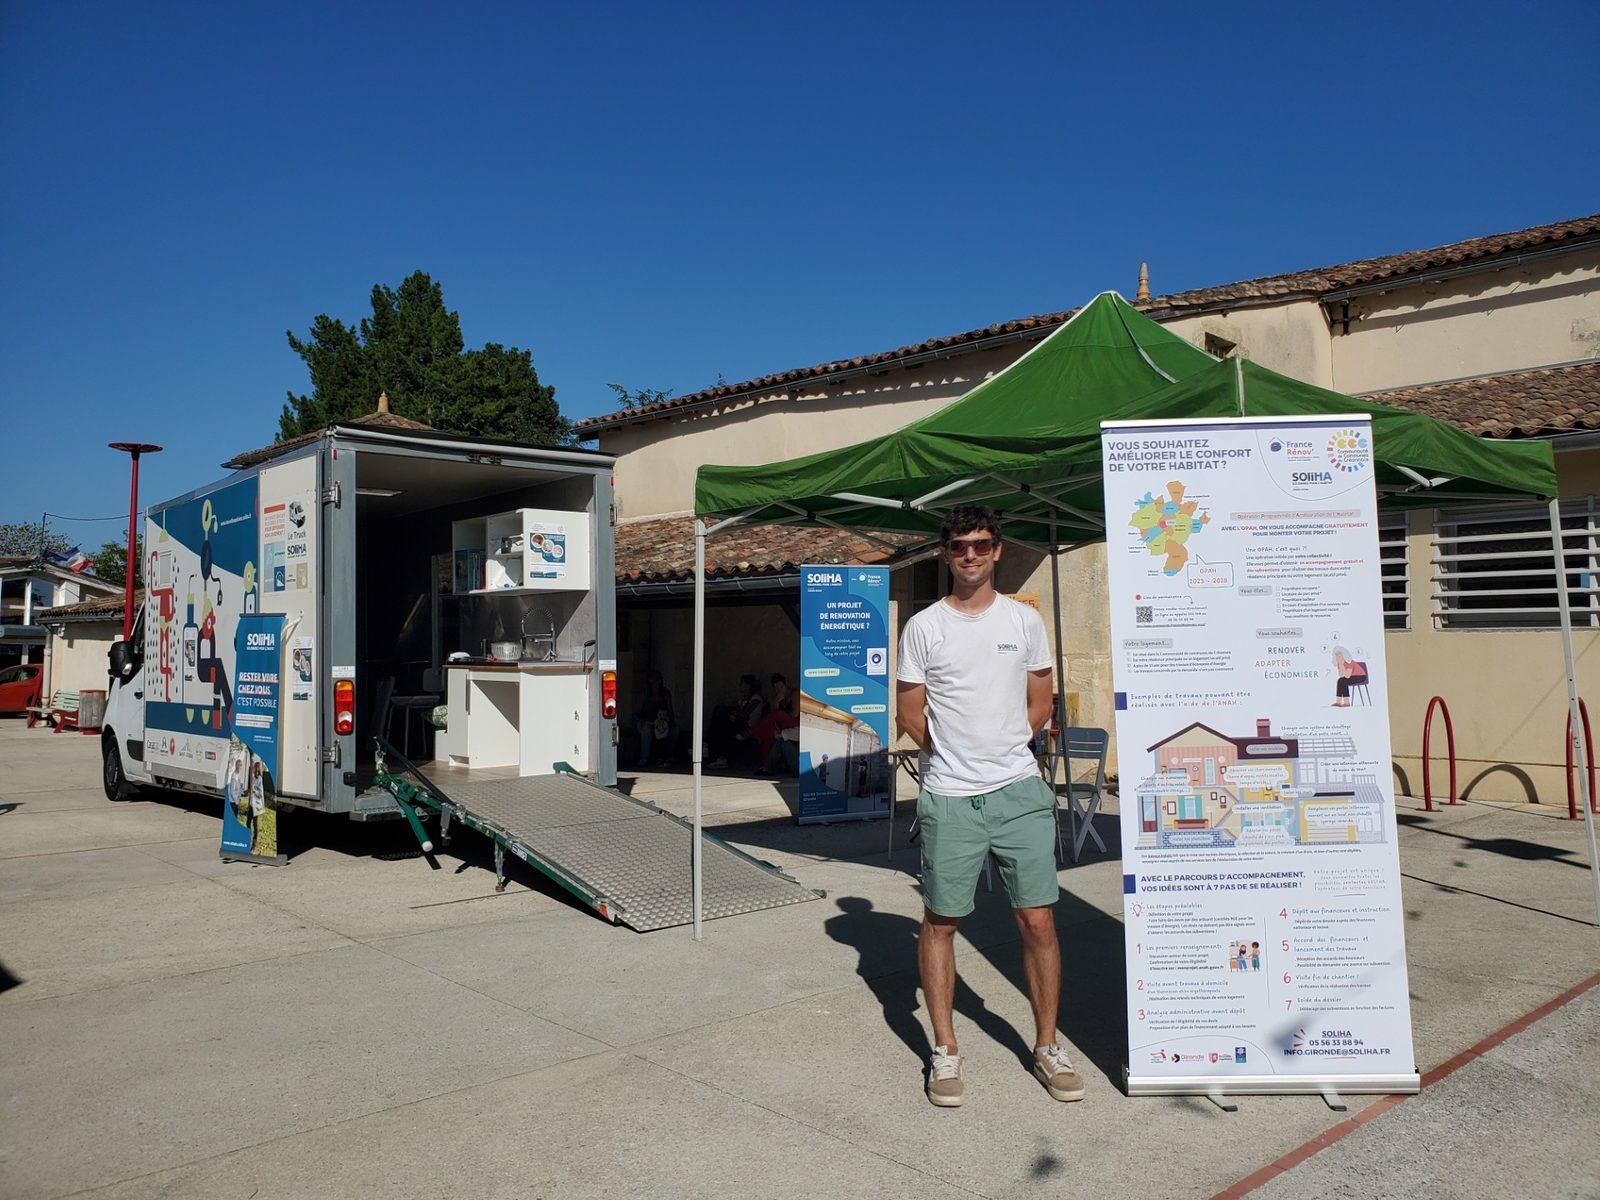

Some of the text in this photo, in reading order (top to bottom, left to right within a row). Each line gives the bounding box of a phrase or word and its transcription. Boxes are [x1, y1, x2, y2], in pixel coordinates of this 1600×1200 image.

[1108, 439, 1209, 451] VOUS SOUHAITEZ
[1108, 448, 1252, 462] AMÉLIORER LE CONFORT
[1286, 448, 1314, 456] Rénov'
[1109, 460, 1227, 473] DE VOTRE HABITAT ?
[288, 532, 293, 540] Le
[830, 612, 871, 620] RENOVATION
[820, 622, 865, 631] ÉNERGÉTIQUE
[1126, 640, 1140, 648] Votre
[1267, 646, 1305, 655] RENOVER
[1255, 659, 1292, 668] ADAPTER
[239, 672, 261, 682] RESTER
[1264, 669, 1320, 680] ÉCONOMISER
[238, 684, 254, 694] CHEZ
[1131, 693, 1161, 702] Exemples
[1205, 691, 1234, 699] pouvant
[237, 697, 278, 709] C'EST POSSIBLE
[1141, 870, 1306, 883] AVEC LE PARCOURS D'ACCOMPAGNEMENT,
[1141, 884, 1157, 893] VOS
[1159, 883, 1182, 892] IDÉES
[1183, 884, 1204, 892] SONT
[1206, 882, 1212, 891] À
[1220, 883, 1236, 891] PAS
[1237, 883, 1247, 891] DE
[1249, 882, 1259, 890] SE
[1260, 880, 1298, 890] RÉALISER
[1279, 907, 1288, 920] 4
[1321, 906, 1351, 916] financeurs
[1137, 943, 1142, 955] 1
[1282, 939, 1290, 952] 5
[1283, 971, 1292, 984] 6
[1136, 979, 1144, 991] 2
[1285, 999, 1292, 1012] 7
[1138, 1008, 1146, 1021] 3
[1169, 1008, 1210, 1016] administrative
[1321, 1030, 1352, 1038] SOLIHA
[1283, 1048, 1391, 1057] INFO.GIRONDE@SOLIHA.FR
